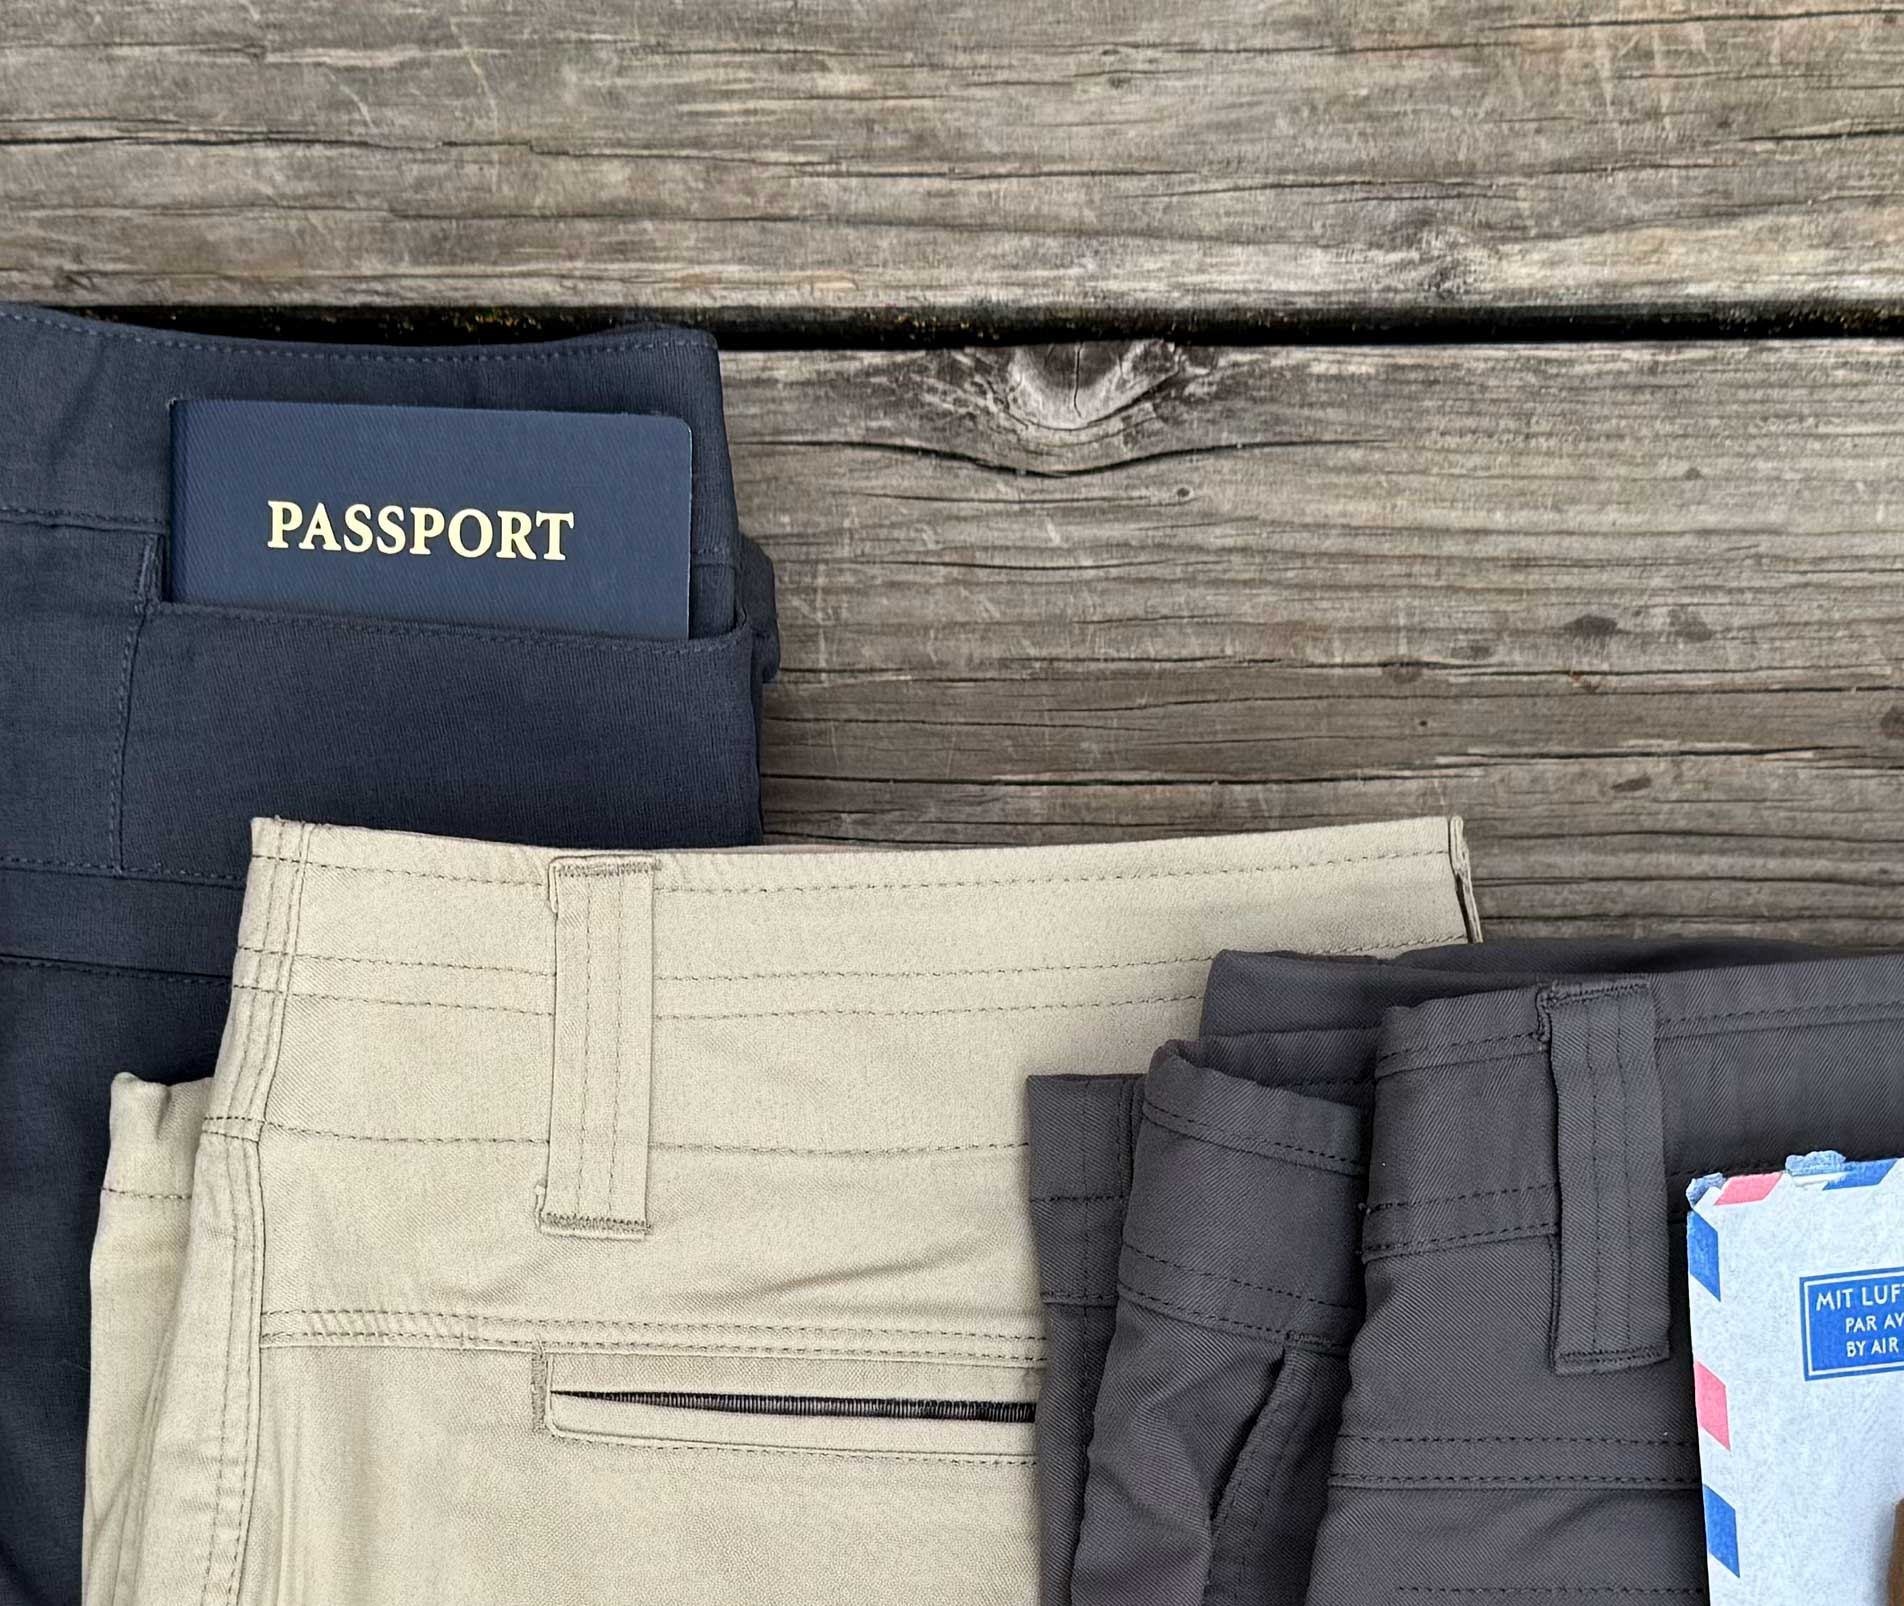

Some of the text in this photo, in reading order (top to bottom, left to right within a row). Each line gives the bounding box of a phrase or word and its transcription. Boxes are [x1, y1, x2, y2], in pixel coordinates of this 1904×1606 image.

[266, 499, 575, 562] PASSPORT
[1815, 1288, 1854, 1312] MIT
[1845, 1315, 1878, 1335] PAR
[1846, 1340, 1867, 1358] BY
[1870, 1337, 1900, 1355] AIR
